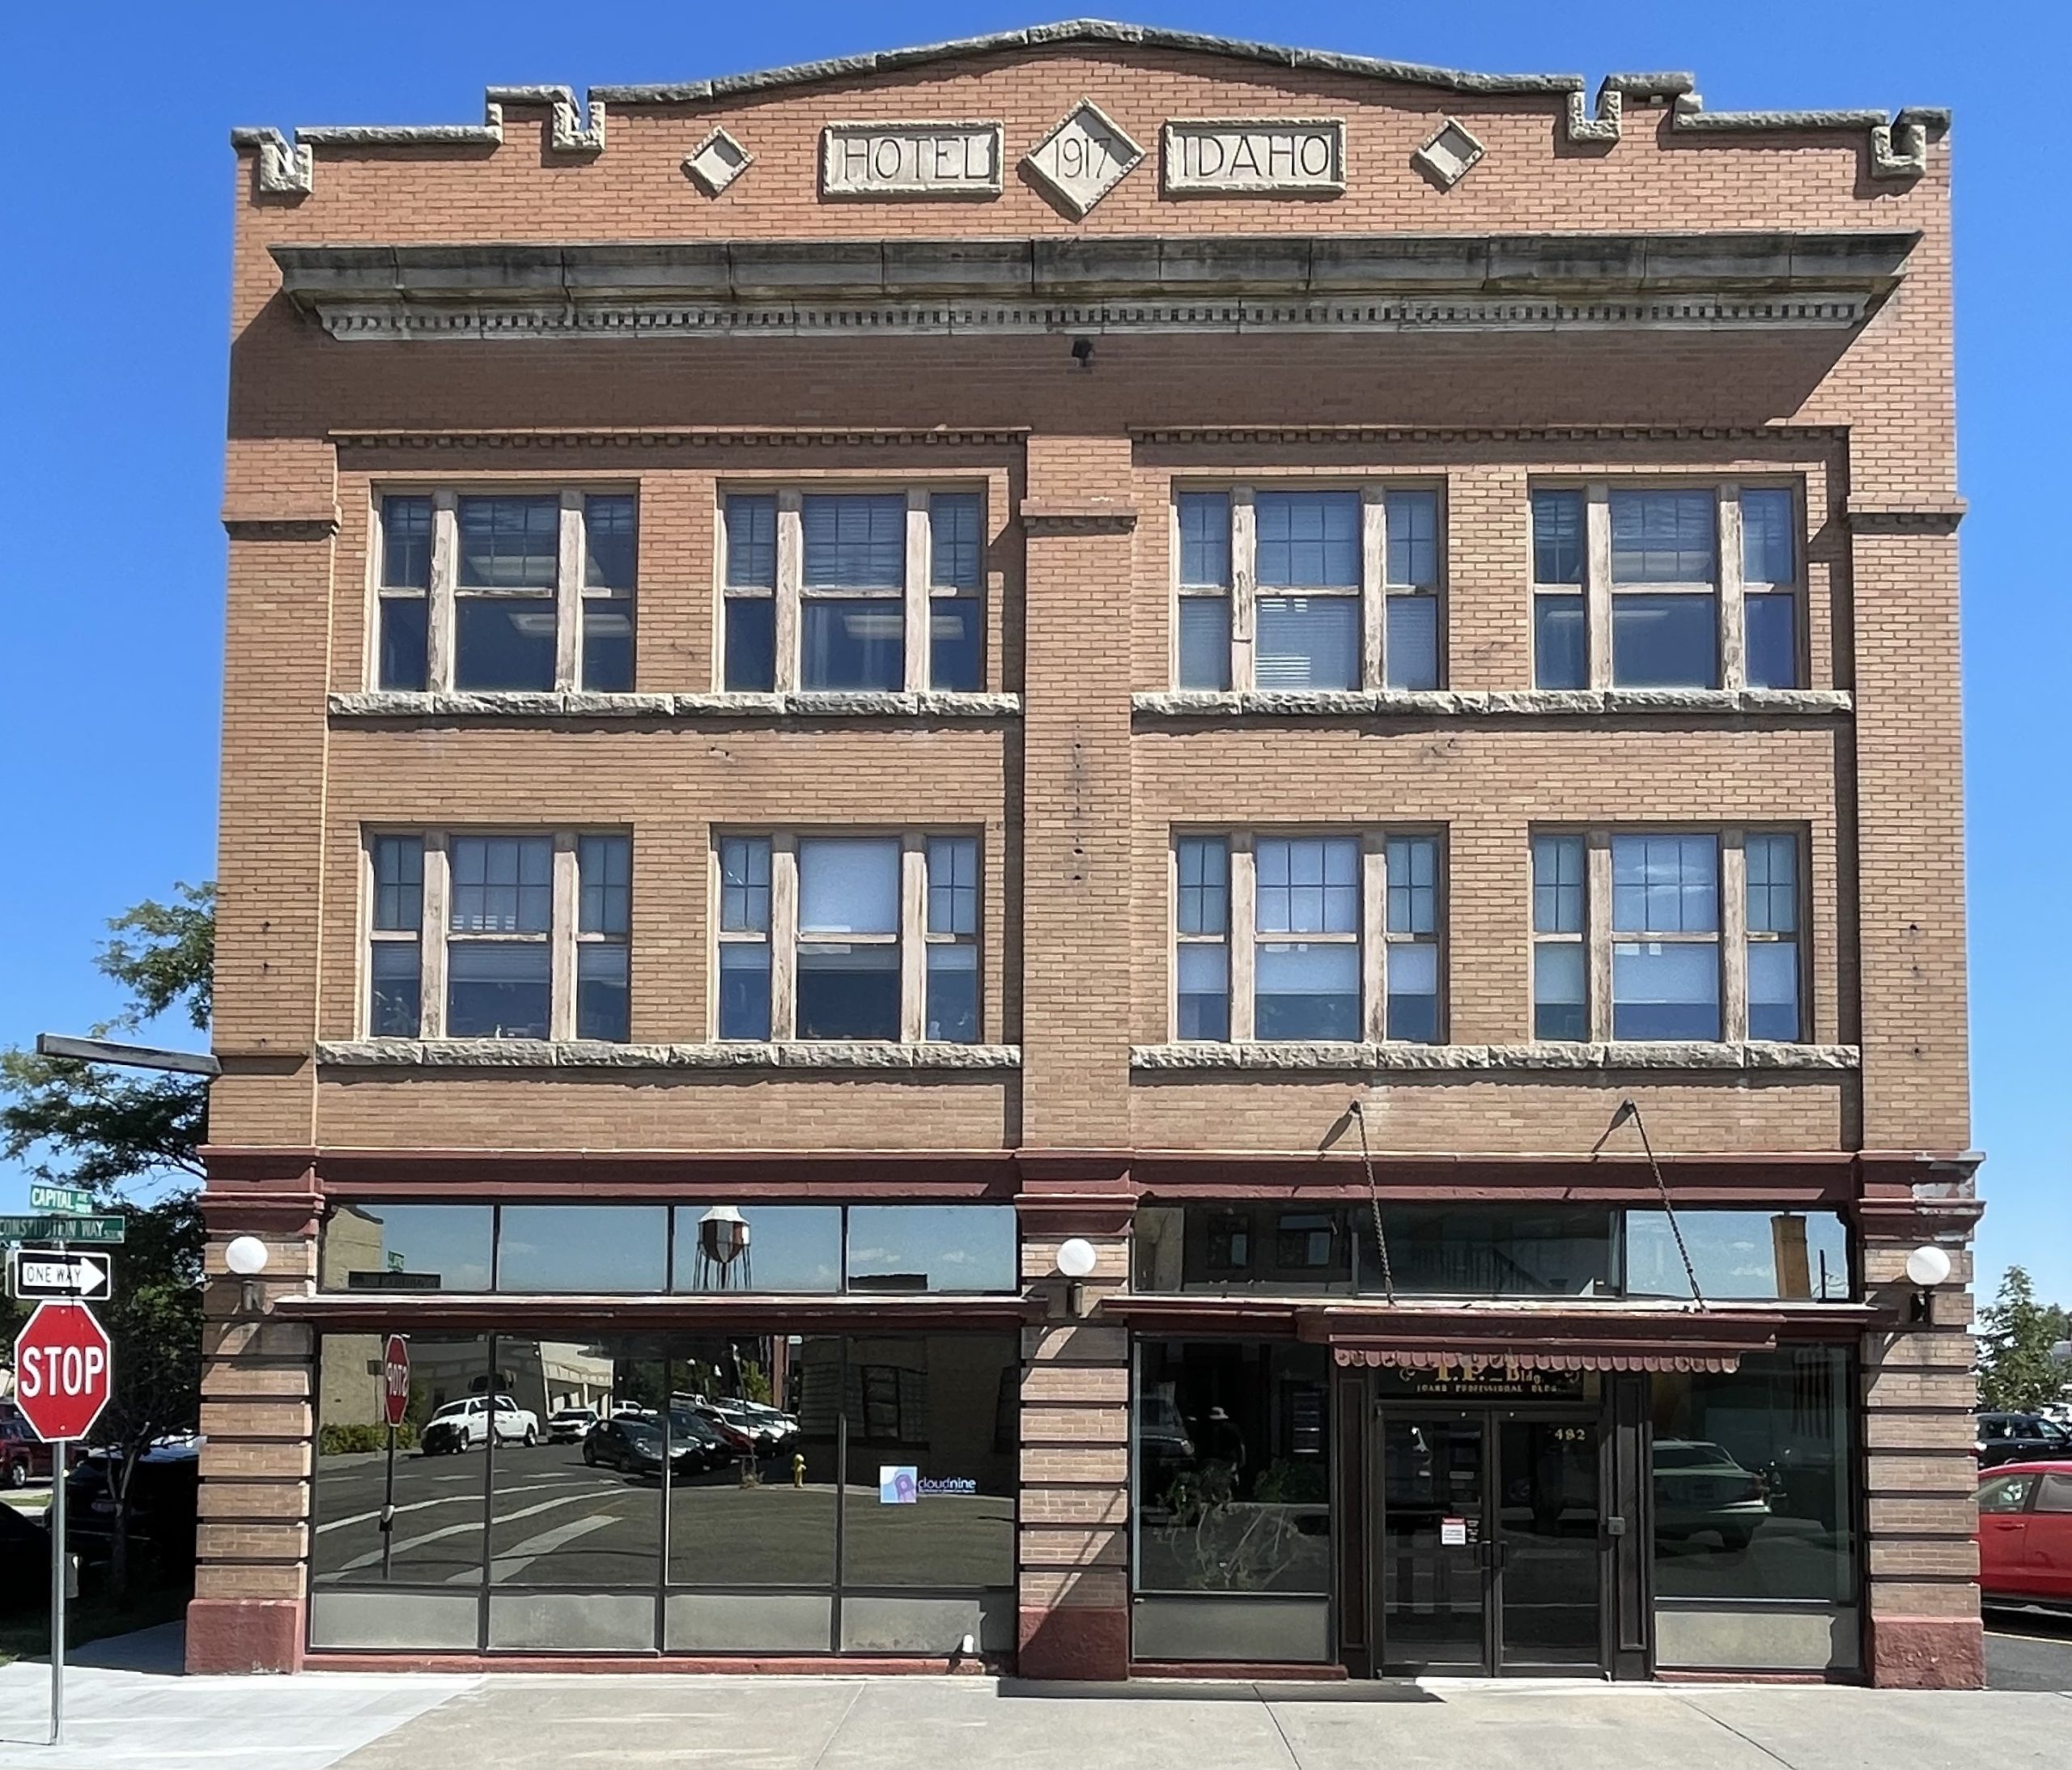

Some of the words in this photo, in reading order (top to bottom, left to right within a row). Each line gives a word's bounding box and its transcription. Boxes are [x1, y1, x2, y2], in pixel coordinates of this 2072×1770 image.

[843, 137, 990, 180] HOTEL
[1055, 137, 1111, 178] 1917
[1182, 134, 1329, 176] IDAHO
[32, 1187, 74, 1210] CAPITAL
[82, 1220, 104, 1237] WAY
[27, 1266, 52, 1283] ONE
[57, 1267, 81, 1284] WAY
[21, 1346, 104, 1398] STOP
[917, 1476, 977, 1490] cloudnine
